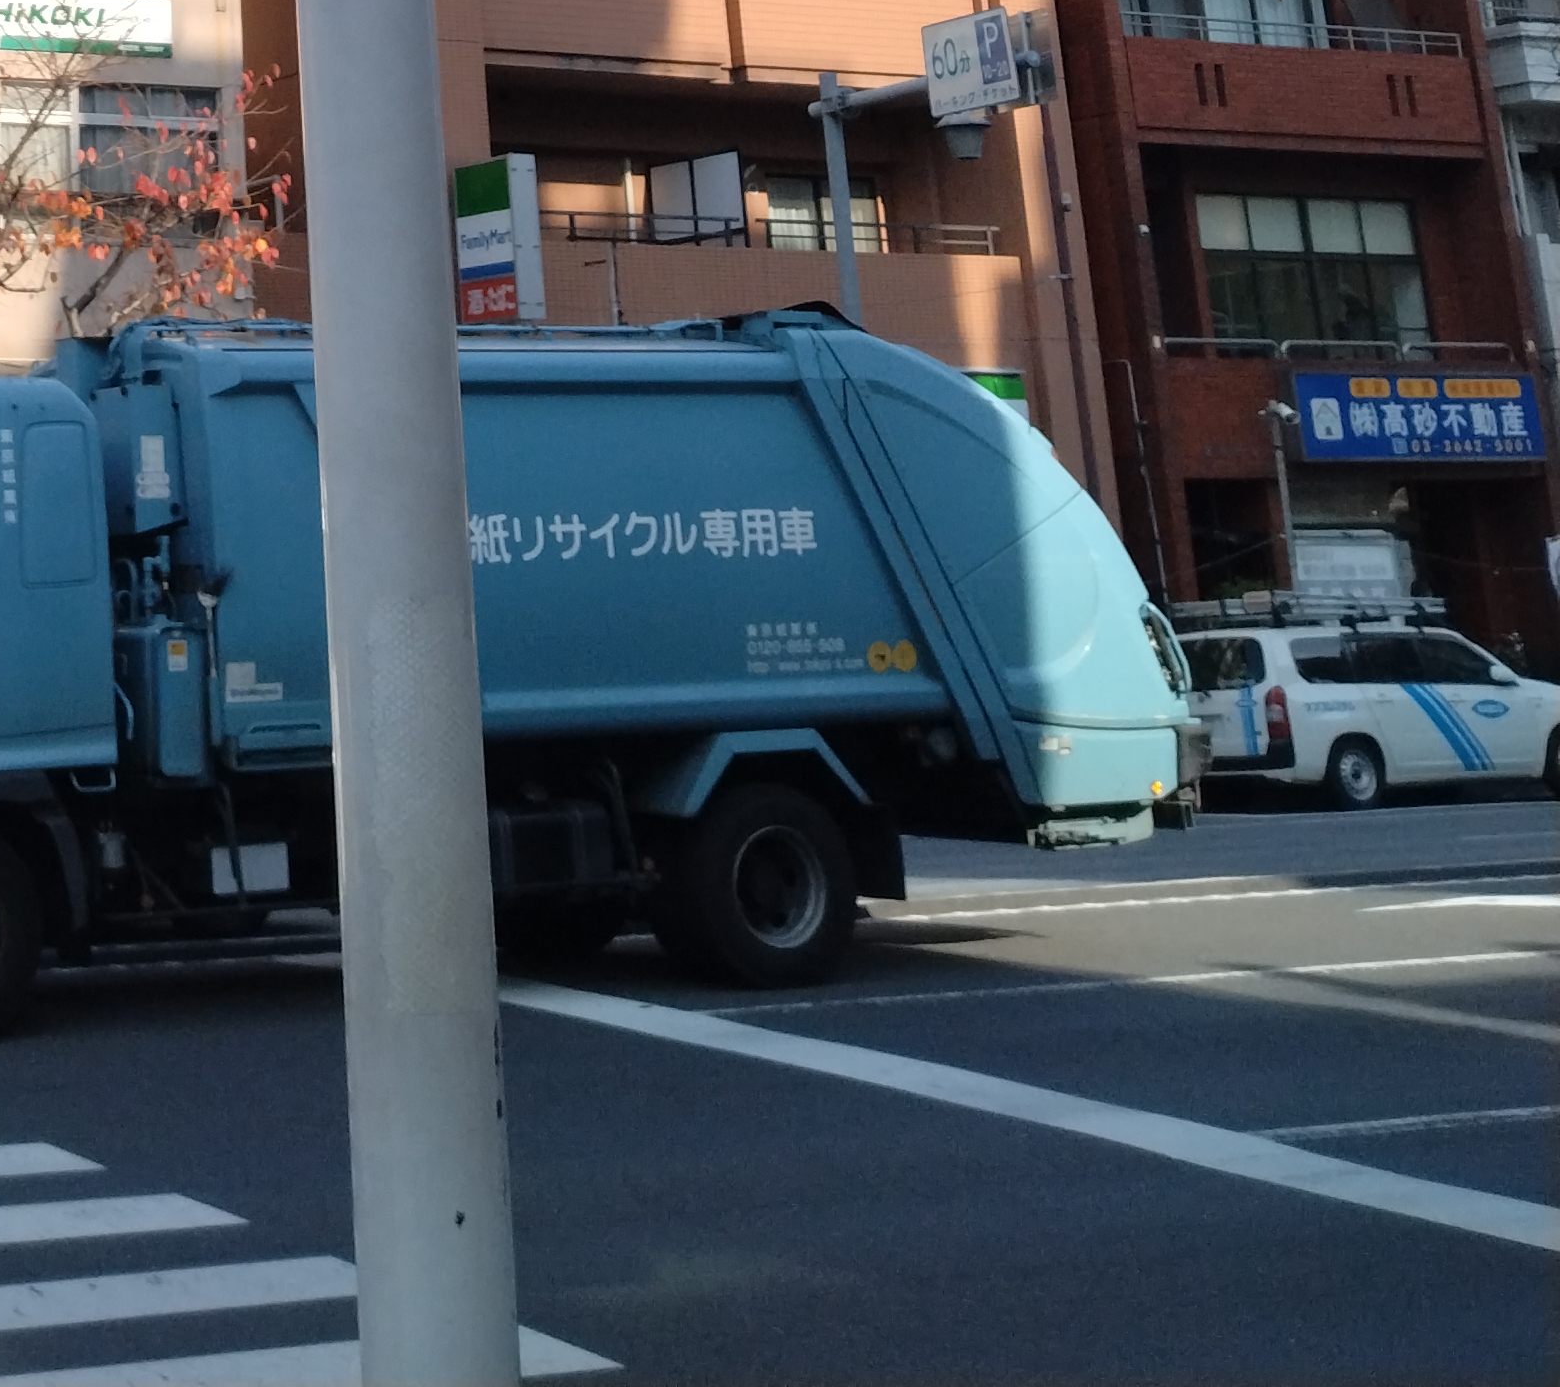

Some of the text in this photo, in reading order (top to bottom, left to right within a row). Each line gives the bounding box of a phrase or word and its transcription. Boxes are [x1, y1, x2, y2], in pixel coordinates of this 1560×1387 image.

[983, 22, 999, 59] P
[468, 506, 818, 565] 紙リサイクル専用車
